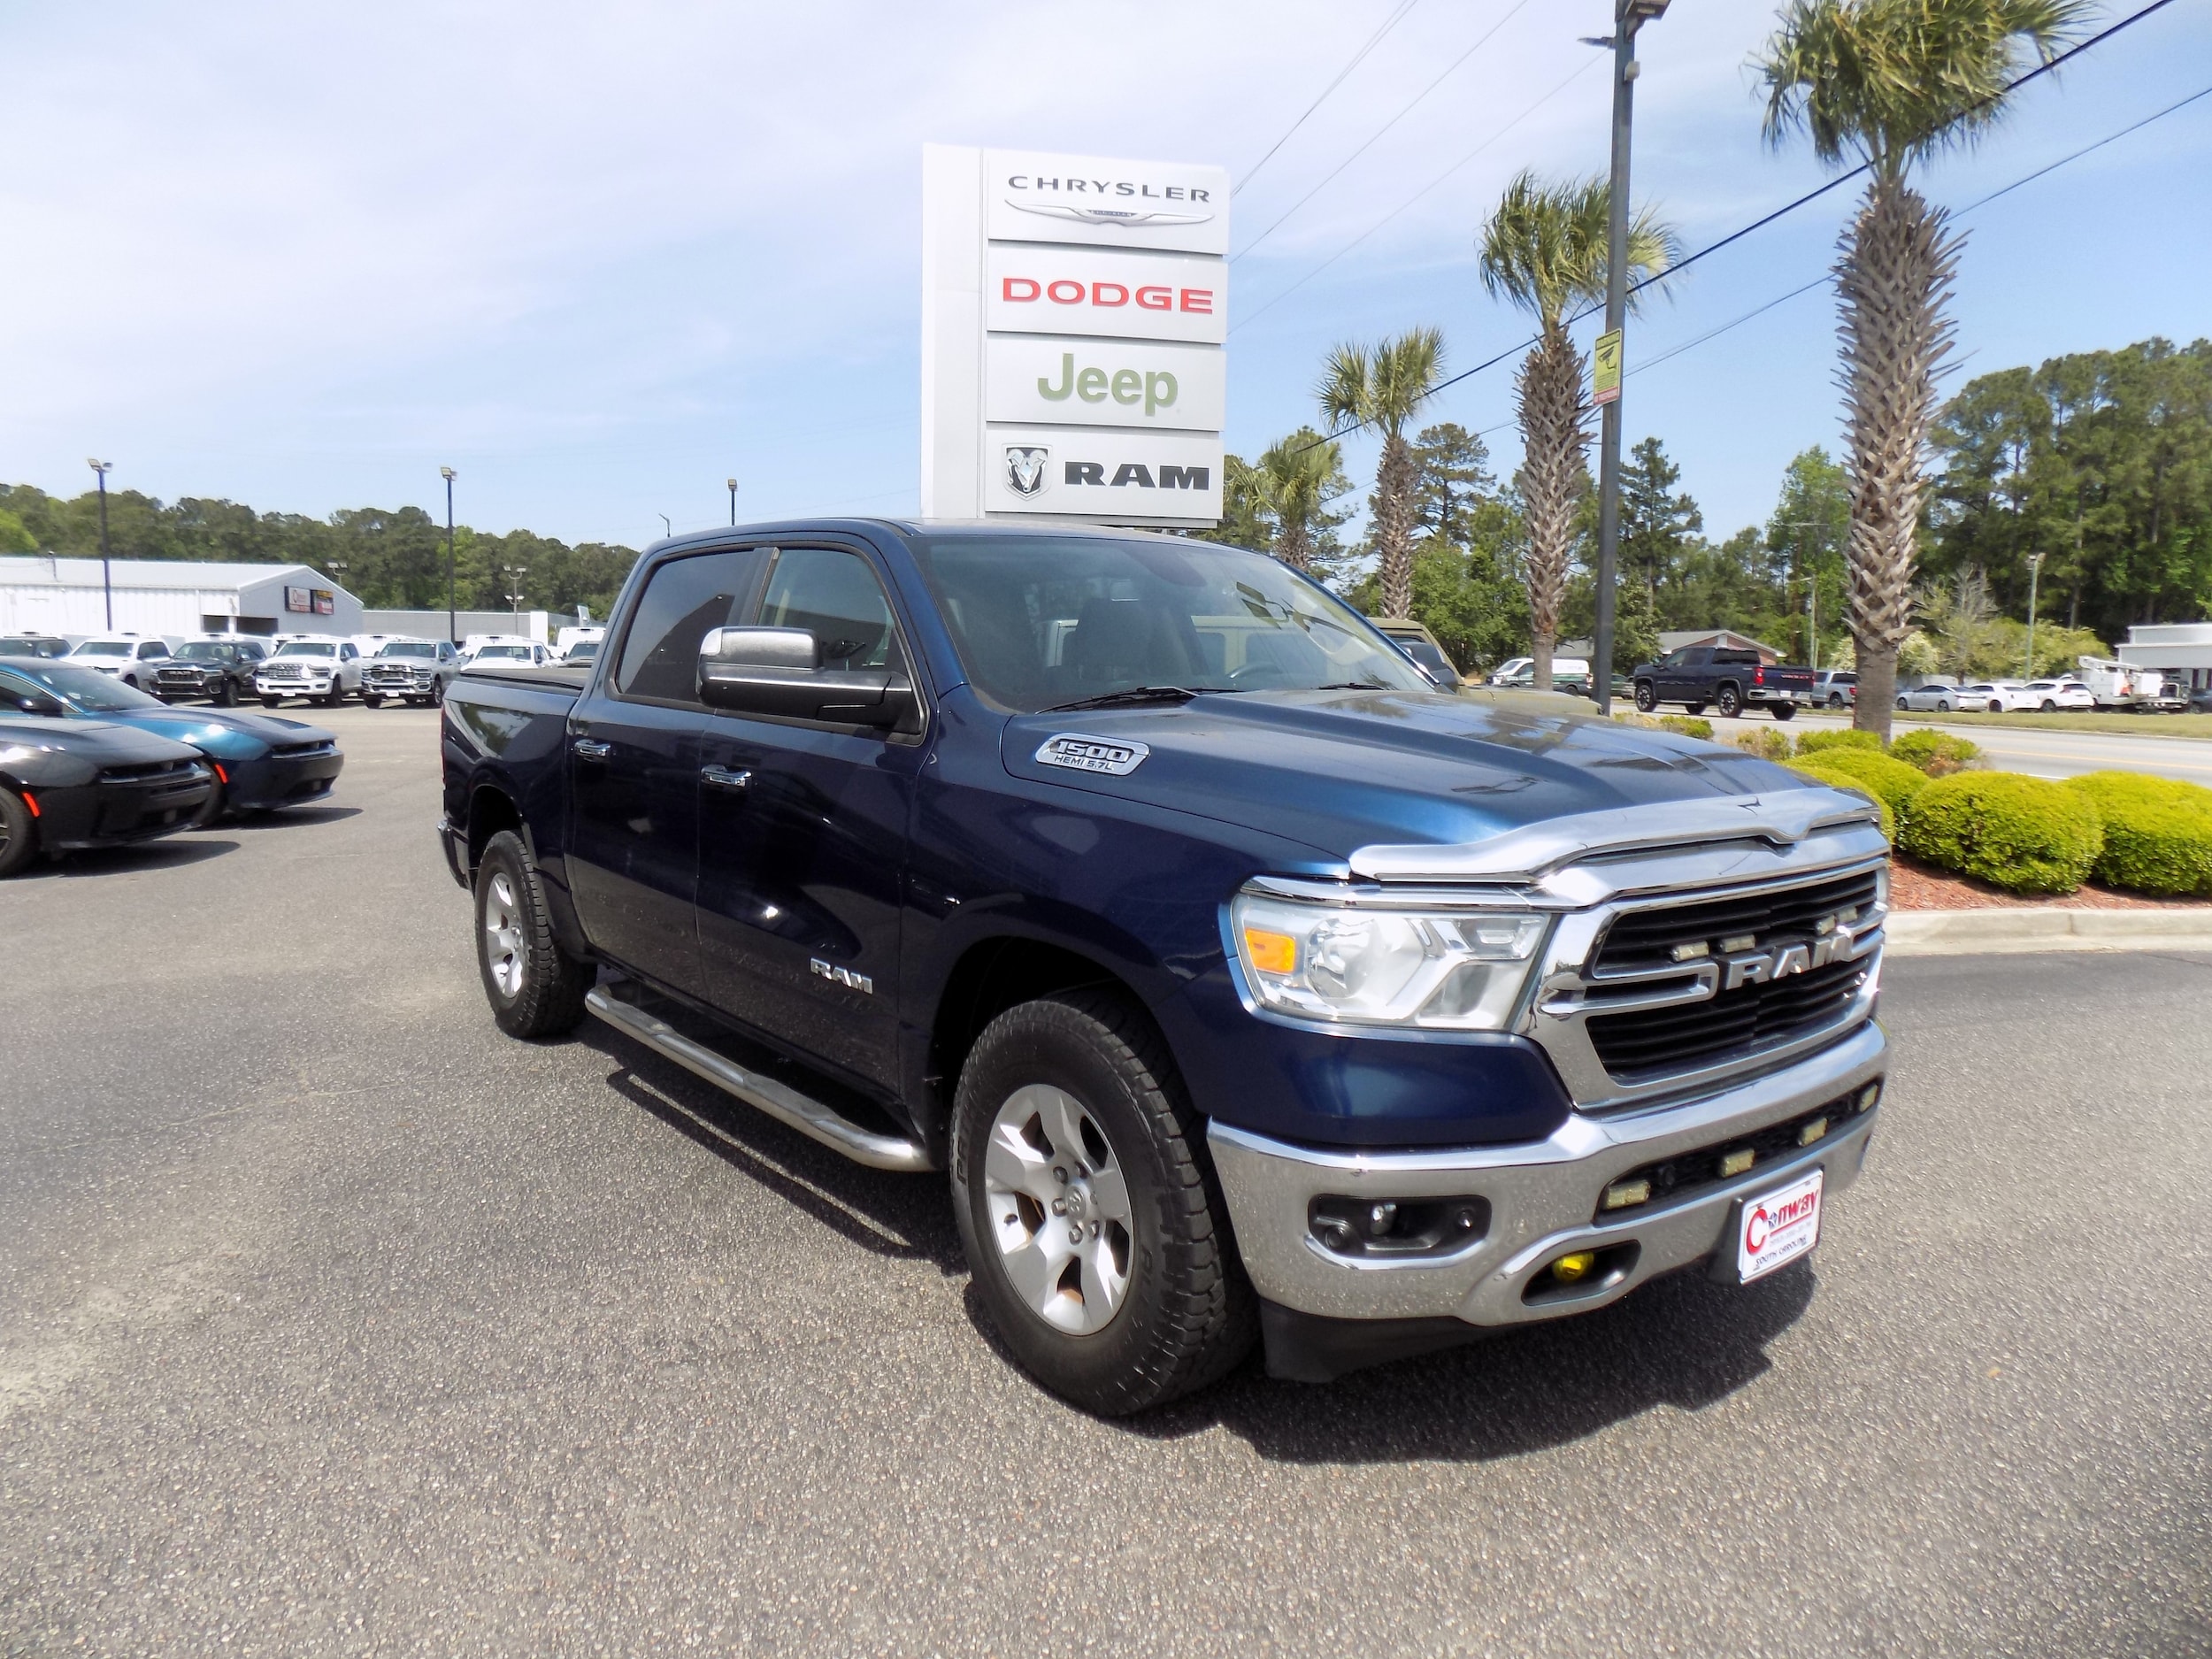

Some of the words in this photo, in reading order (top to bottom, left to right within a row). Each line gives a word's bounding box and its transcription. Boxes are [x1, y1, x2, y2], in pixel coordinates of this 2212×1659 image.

[1008, 175, 1210, 204] CHRYSLER
[1002, 277, 1214, 315] DODGE
[1037, 352, 1179, 417] Jeep
[1064, 460, 1210, 490] RAM
[1054, 755, 1084, 766] HEMI
[1086, 759, 1114, 771] 5.7L
[1057, 741, 1131, 763] 1500
[810, 957, 873, 995] RAM
[1725, 932, 1852, 991] RAM
